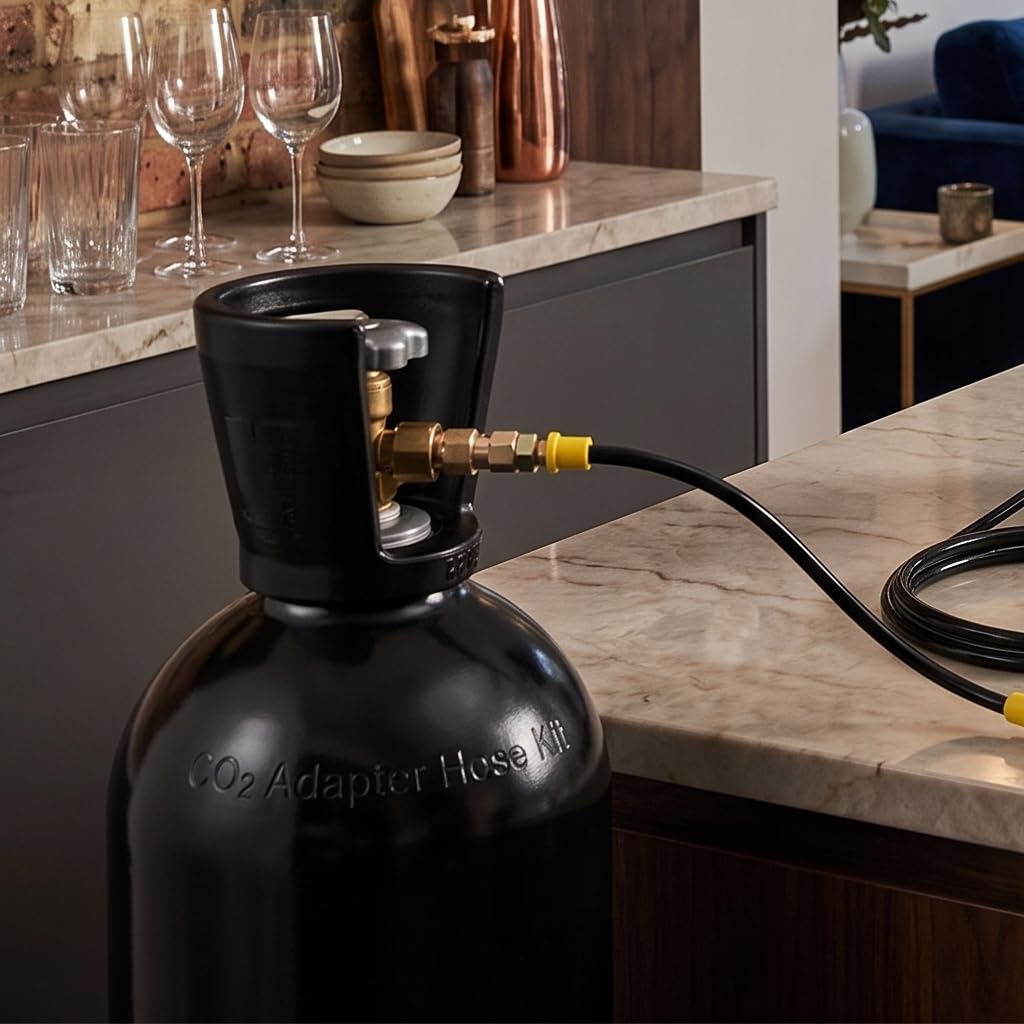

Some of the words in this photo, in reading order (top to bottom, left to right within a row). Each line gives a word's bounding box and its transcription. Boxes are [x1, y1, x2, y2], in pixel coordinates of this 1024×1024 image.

[264, 762, 428, 808] Adapter
[439, 743, 528, 788] Hose
[529, 719, 572, 762] Kit
